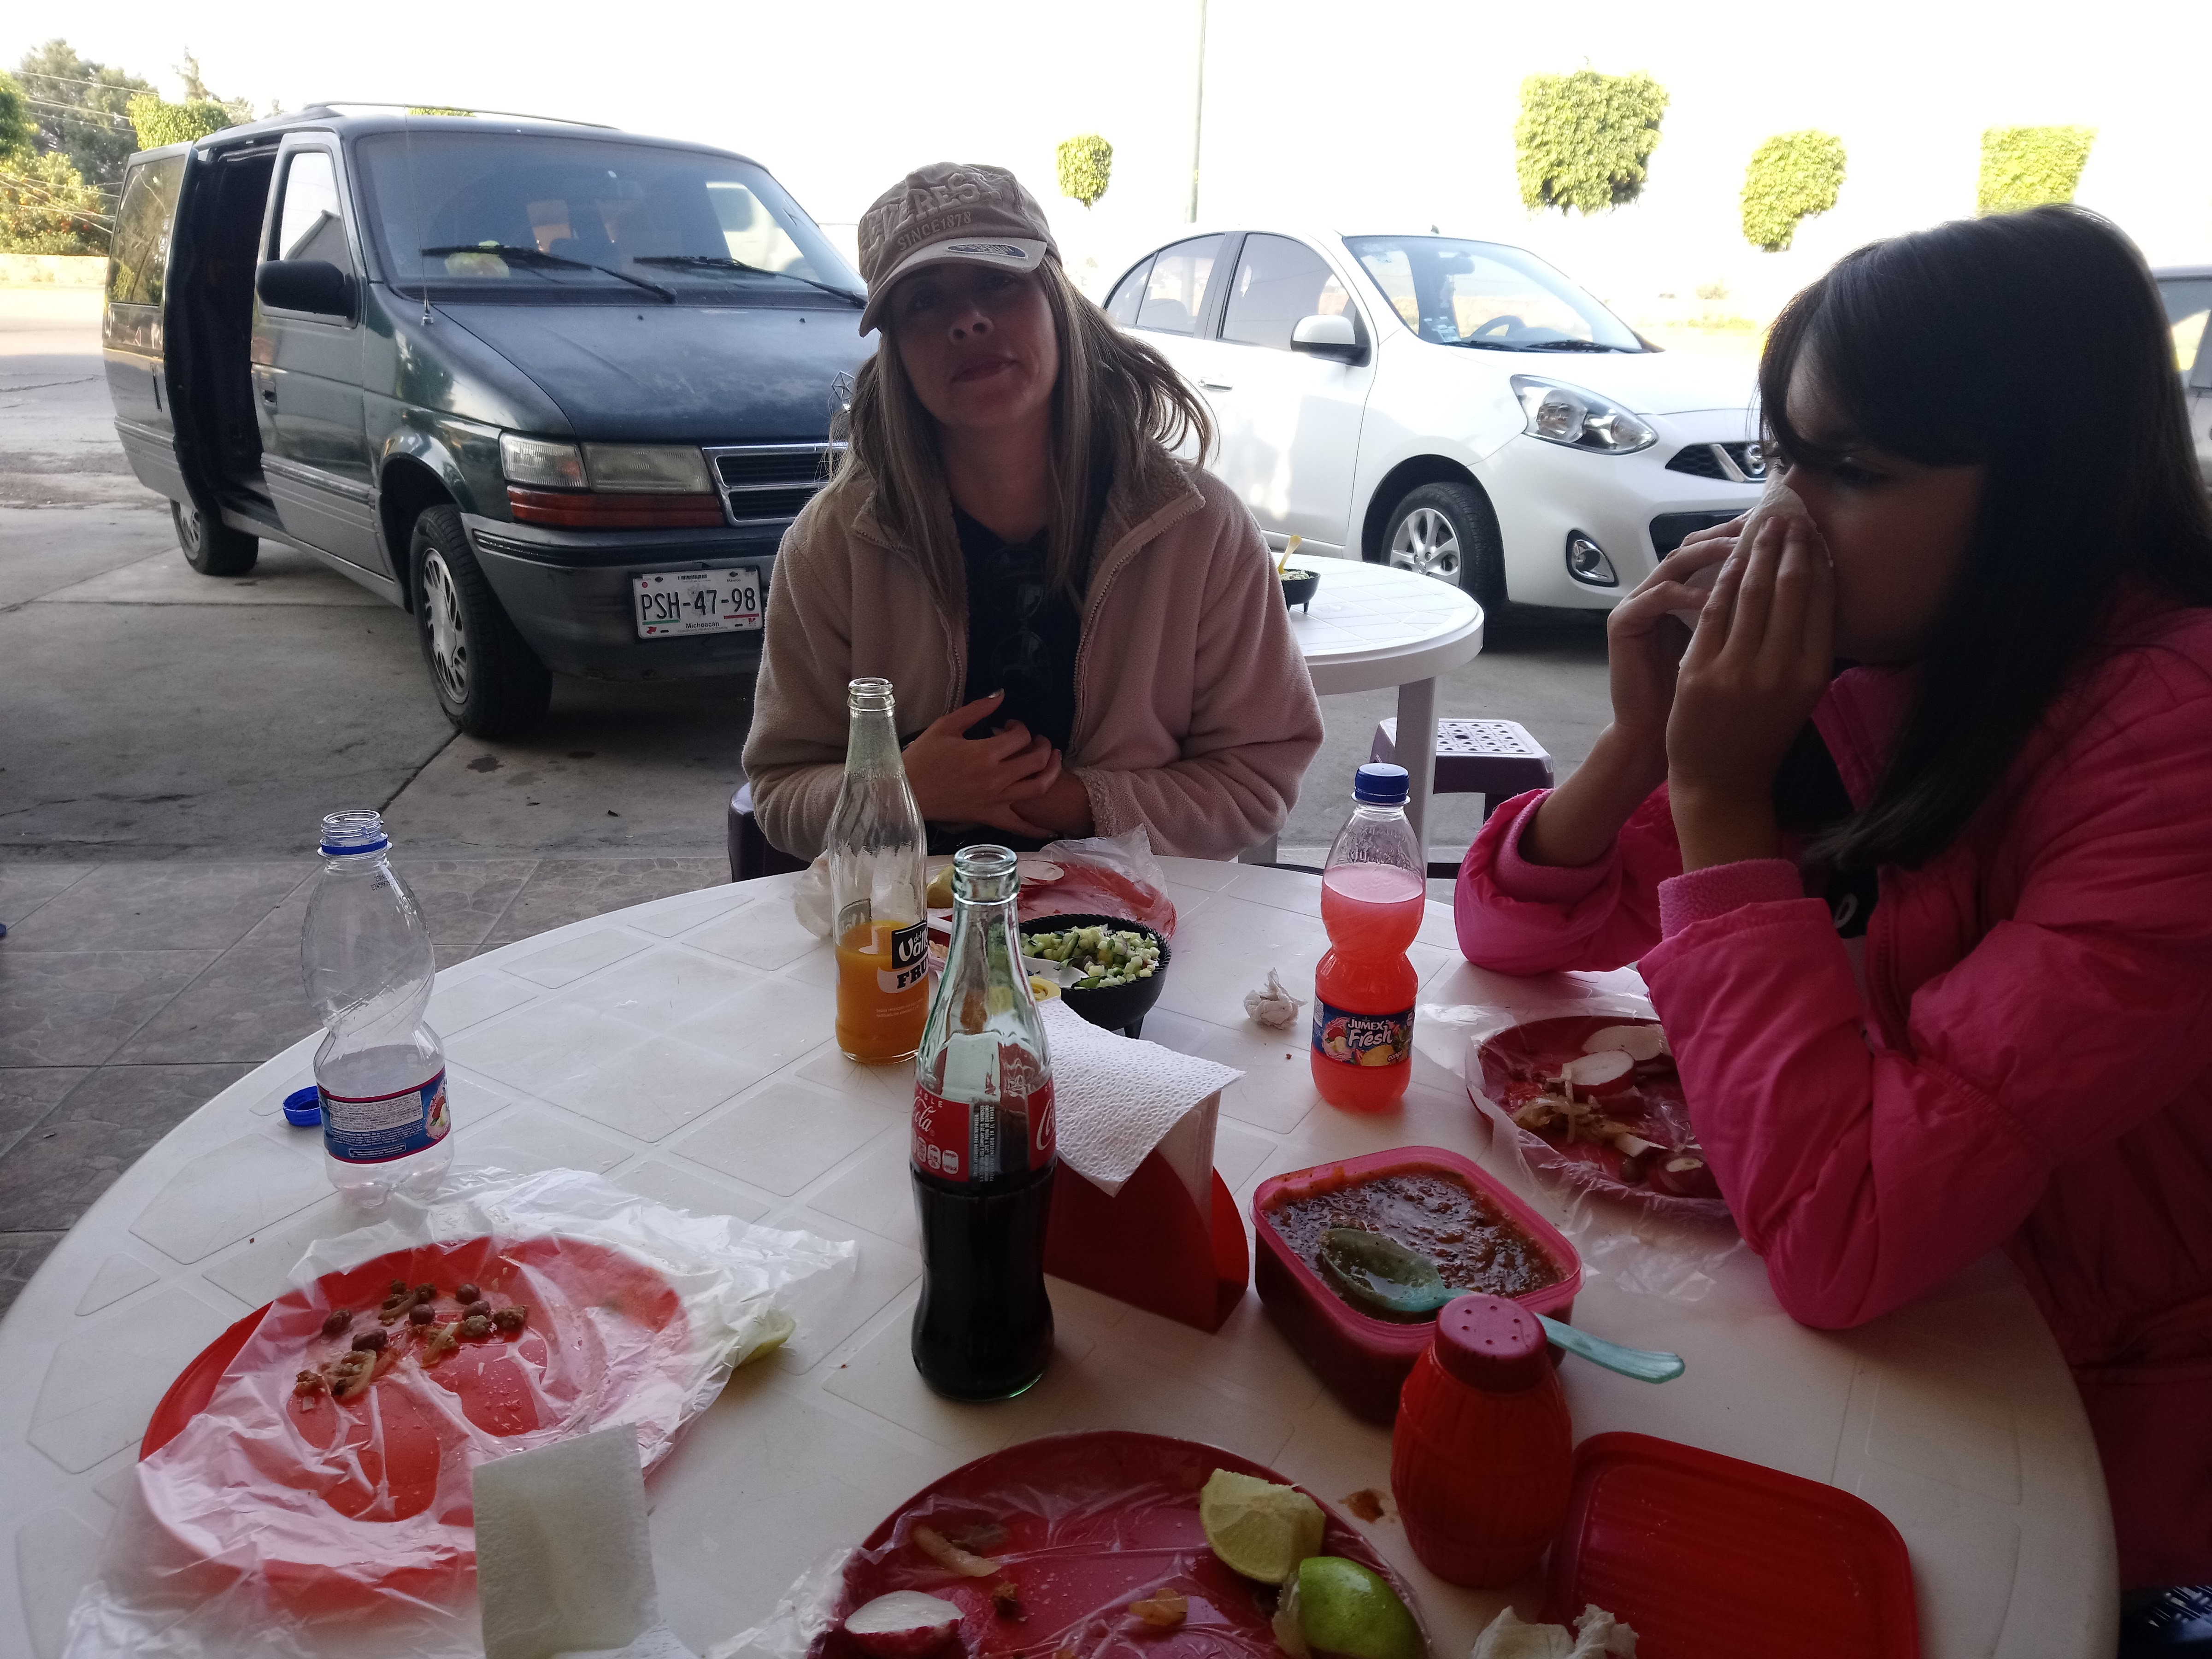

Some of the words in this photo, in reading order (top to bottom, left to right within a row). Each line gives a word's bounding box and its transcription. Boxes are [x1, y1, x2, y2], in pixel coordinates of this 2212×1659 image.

[641, 587, 756, 621] PSH-47-98
[913, 930, 922, 943] del
[1347, 1019, 1384, 1031] JUMEX
[1348, 1025, 1393, 1047] Fresh
